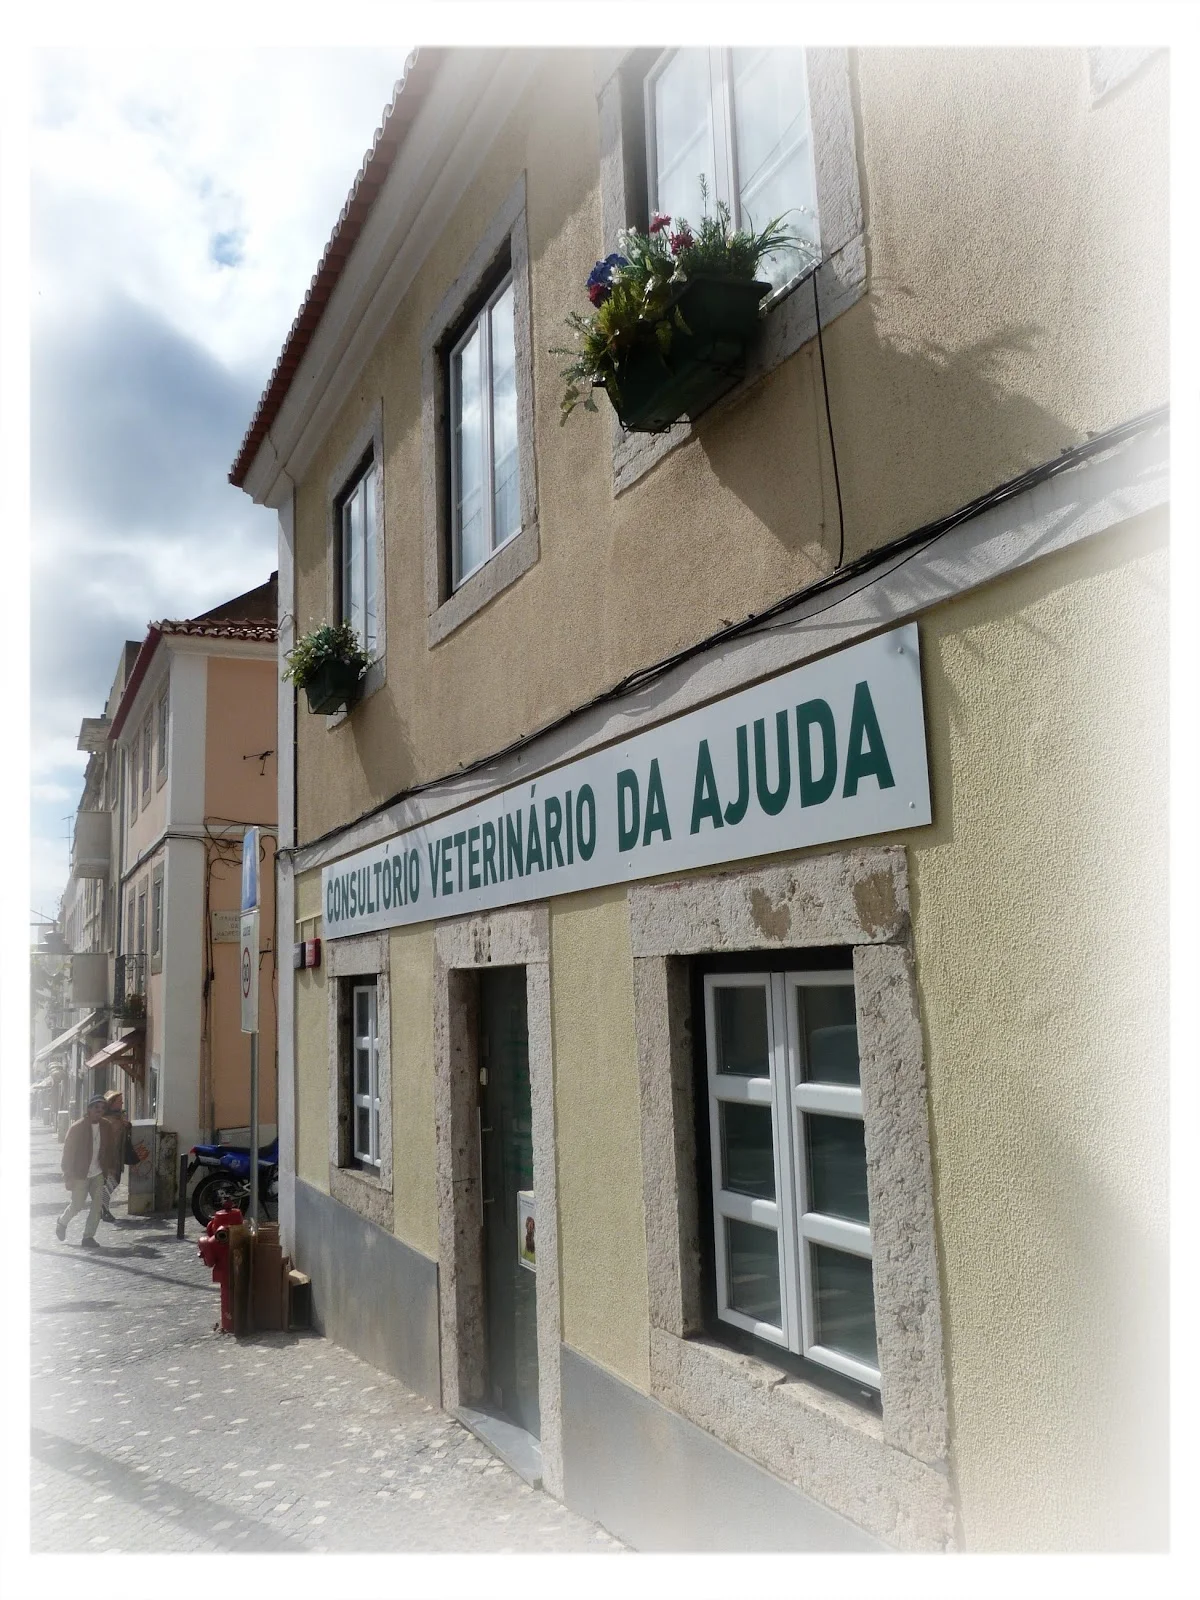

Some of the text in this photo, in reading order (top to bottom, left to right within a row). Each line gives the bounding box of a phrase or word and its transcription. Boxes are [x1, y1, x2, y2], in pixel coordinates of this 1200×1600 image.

[326, 680, 896, 924] CONSULTÓRIO VETERINÁRIO DA AJUDA
